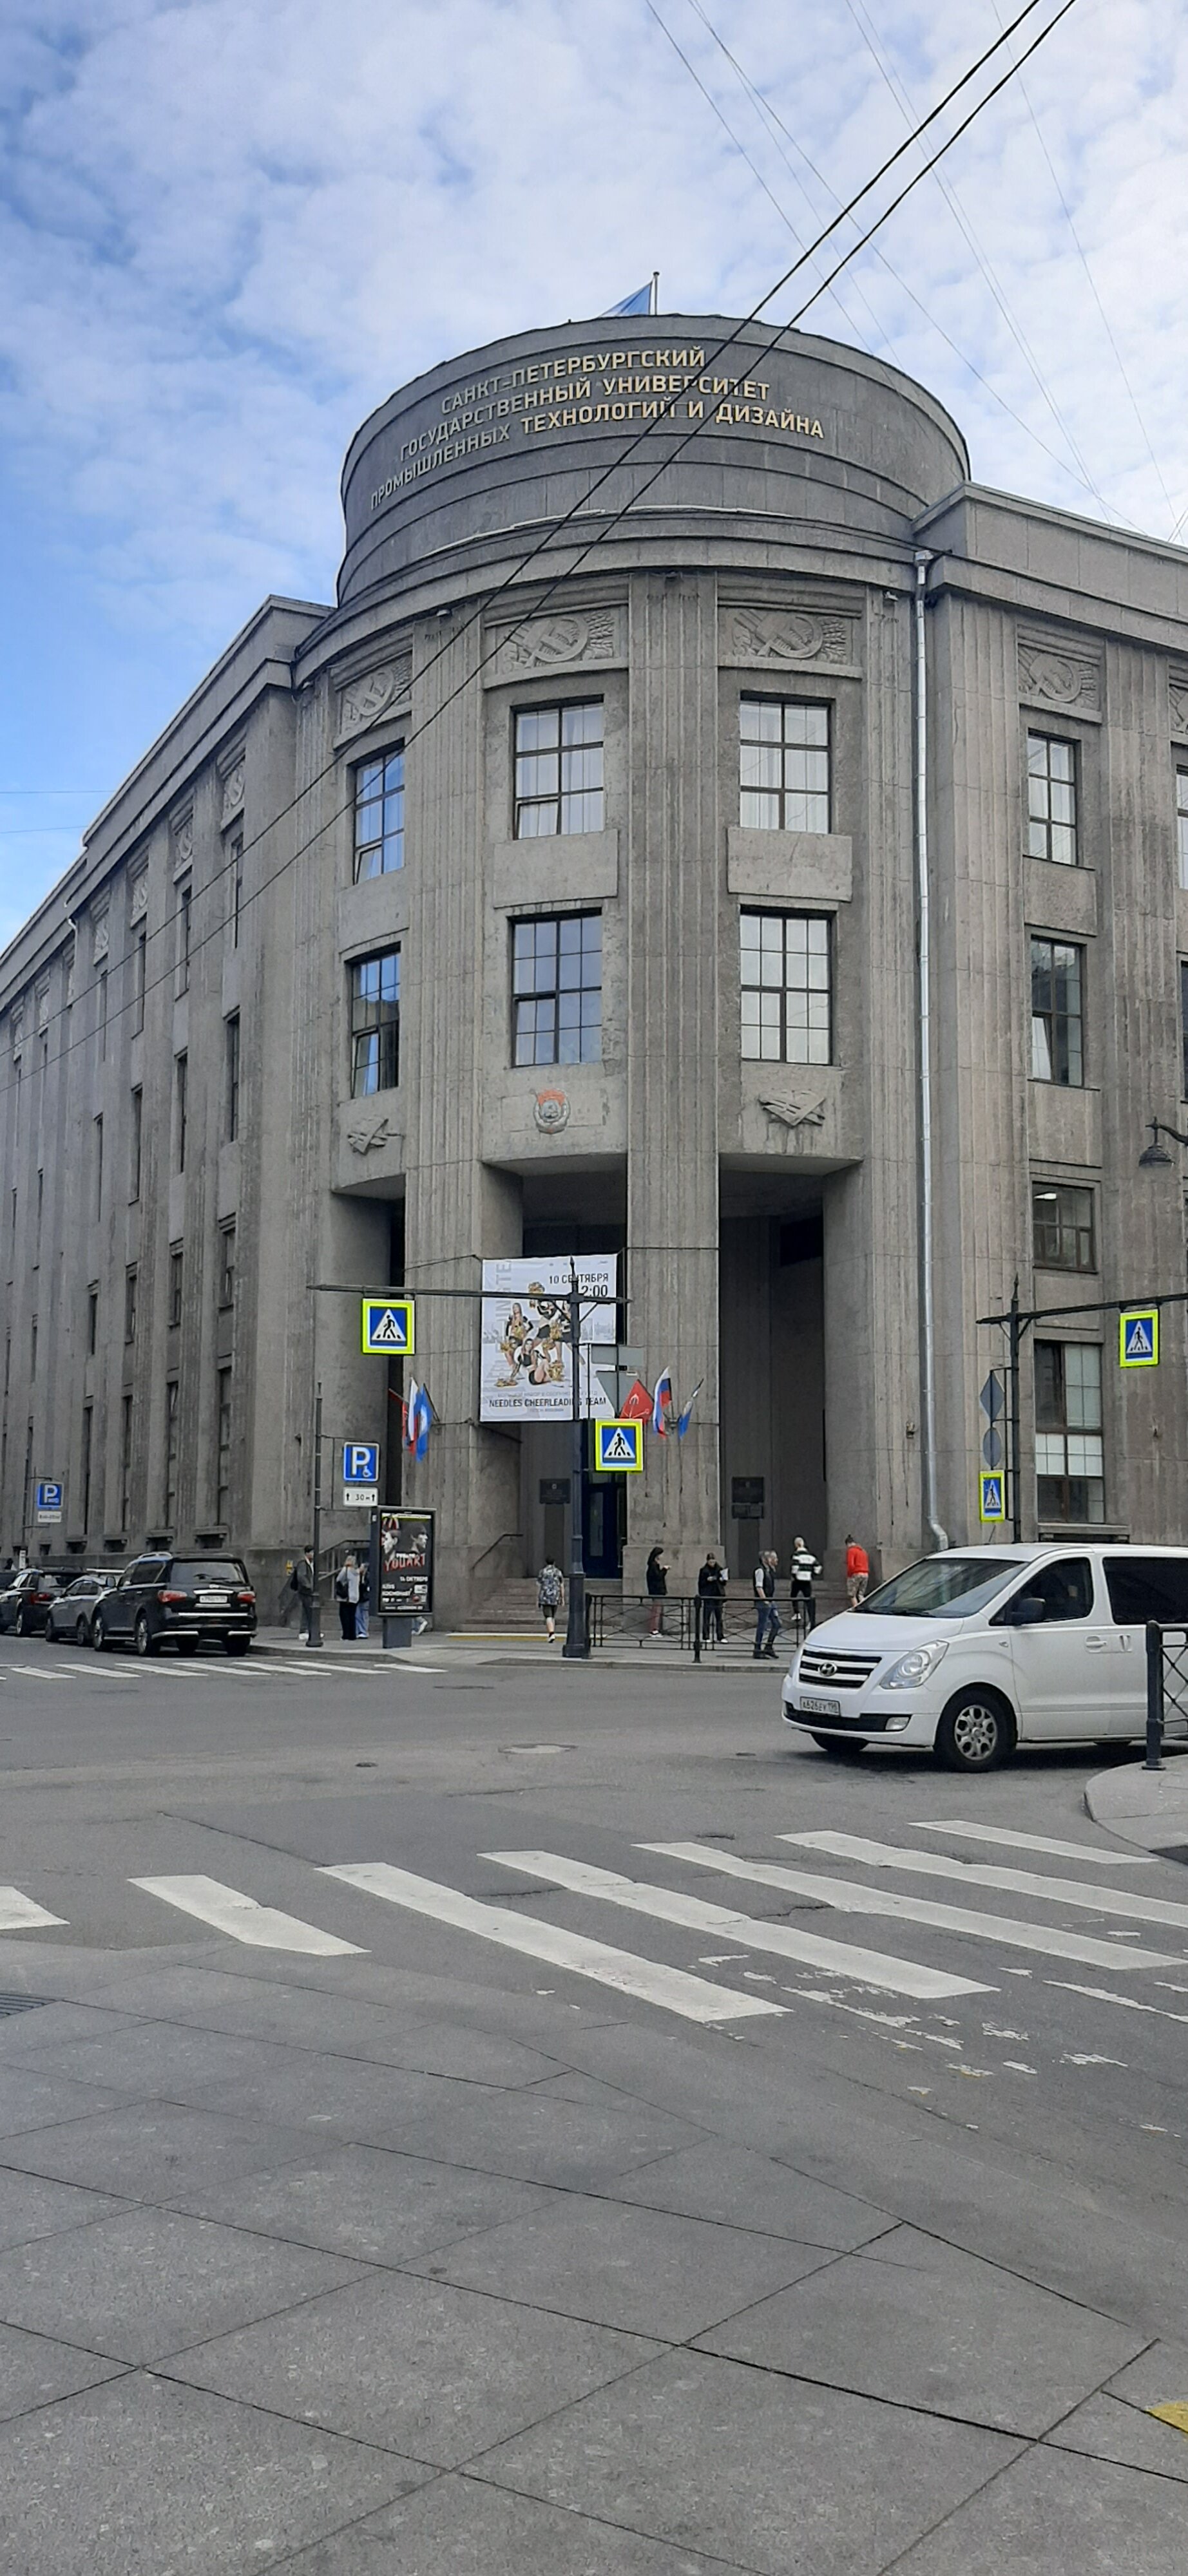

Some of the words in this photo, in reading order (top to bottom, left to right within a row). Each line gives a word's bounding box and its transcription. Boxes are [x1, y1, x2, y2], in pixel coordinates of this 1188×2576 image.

[441, 345, 705, 414] САНКТ-ПЕТЕРБУРГСКИЙ
[399, 376, 591, 462] ГОСУДАРСТВЕННЫЙ
[603, 374, 770, 401] УНИВЕРСИТЕТ
[370, 422, 511, 510] ПРОМЫШЛЕННЫХ
[521, 395, 675, 434] ТЕХНОЛОГИЙ
[689, 401, 704, 419] И
[716, 402, 825, 439] ДИЗАЙНА
[550, 1275, 559, 1285] 10
[489, 1398, 522, 1408] NEEDLES
[524, 1397, 582, 1407] CHEERLEADIG
[352, 1446, 370, 1475] P
[44, 1484, 59, 1504] P
